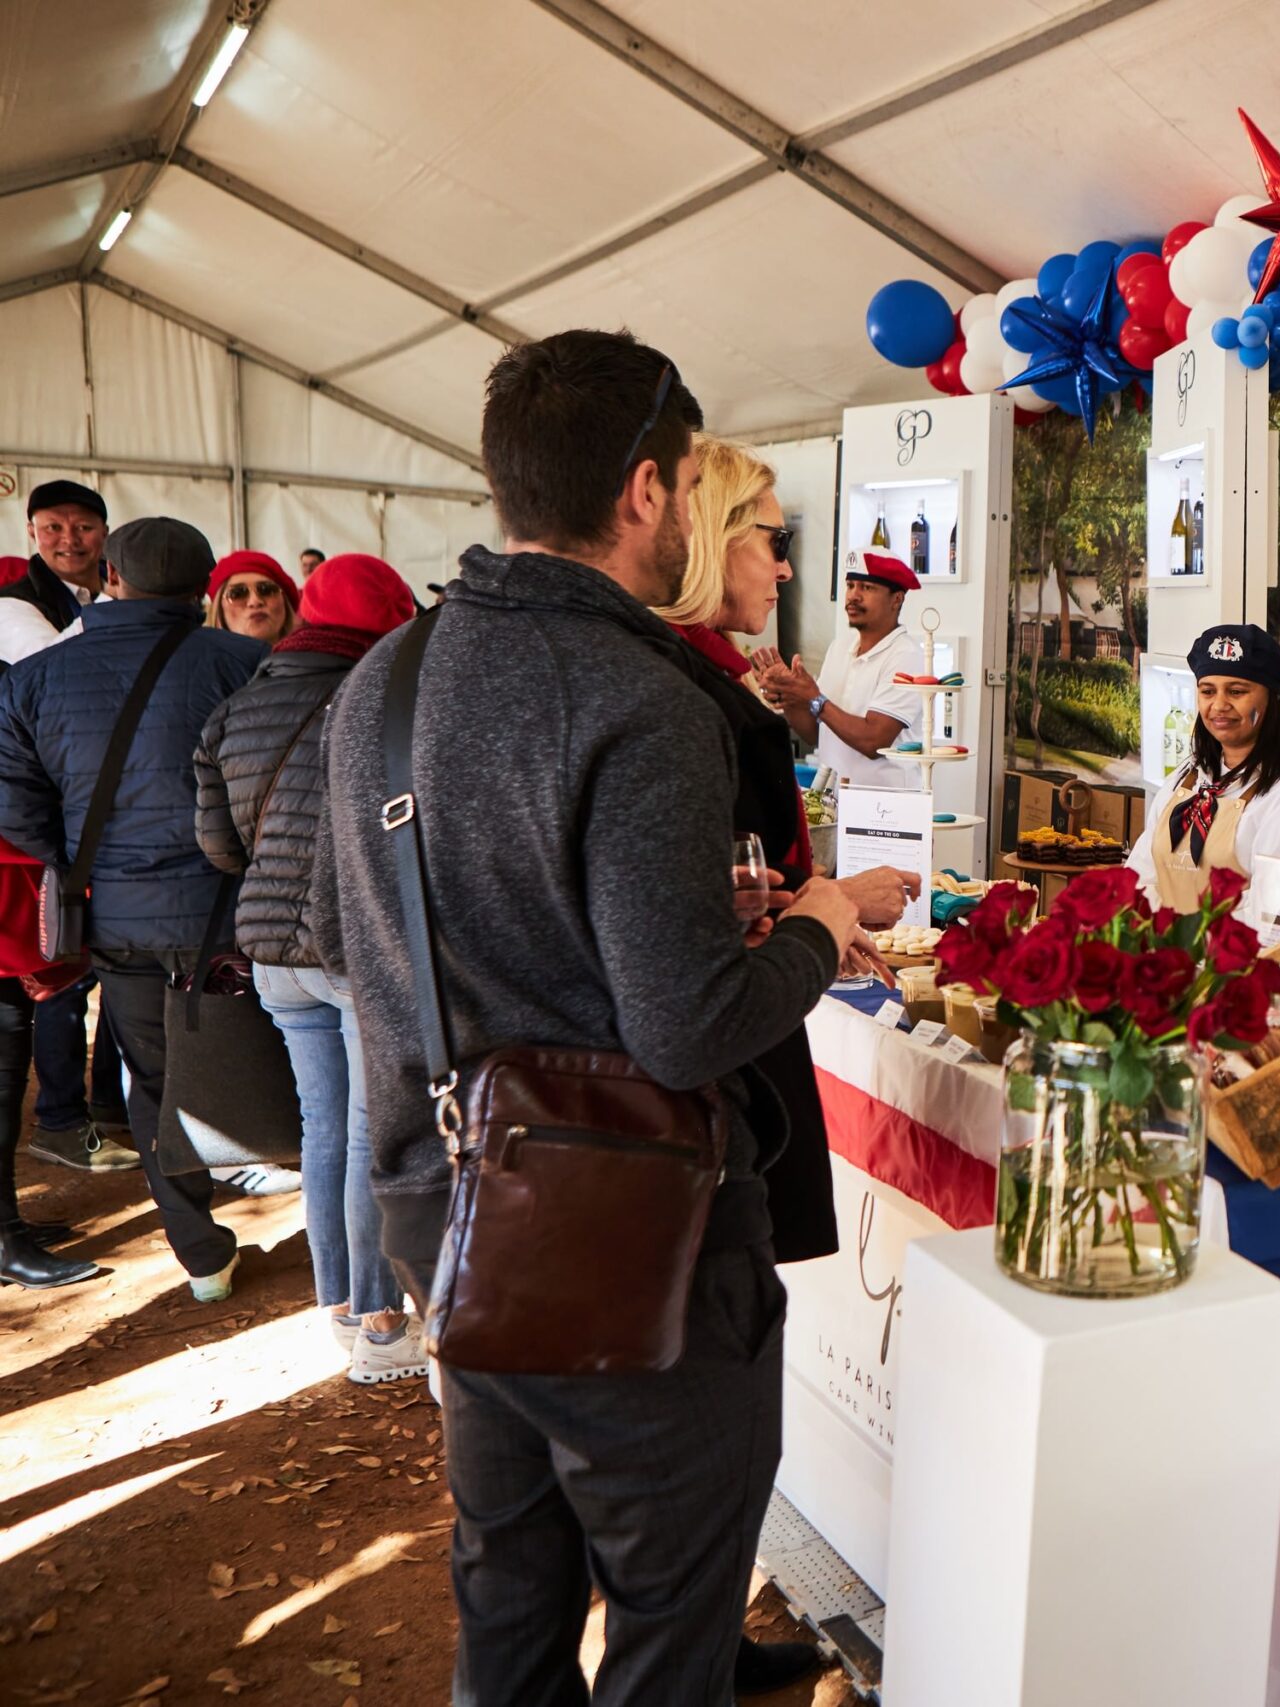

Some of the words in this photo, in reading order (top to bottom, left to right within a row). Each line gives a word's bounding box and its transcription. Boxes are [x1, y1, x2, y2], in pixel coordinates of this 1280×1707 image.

[818, 1335, 835, 1364] LA
[844, 1356, 892, 1411] PARIS
[828, 1380, 859, 1414] CAPE
[867, 1415, 895, 1445] WIN
